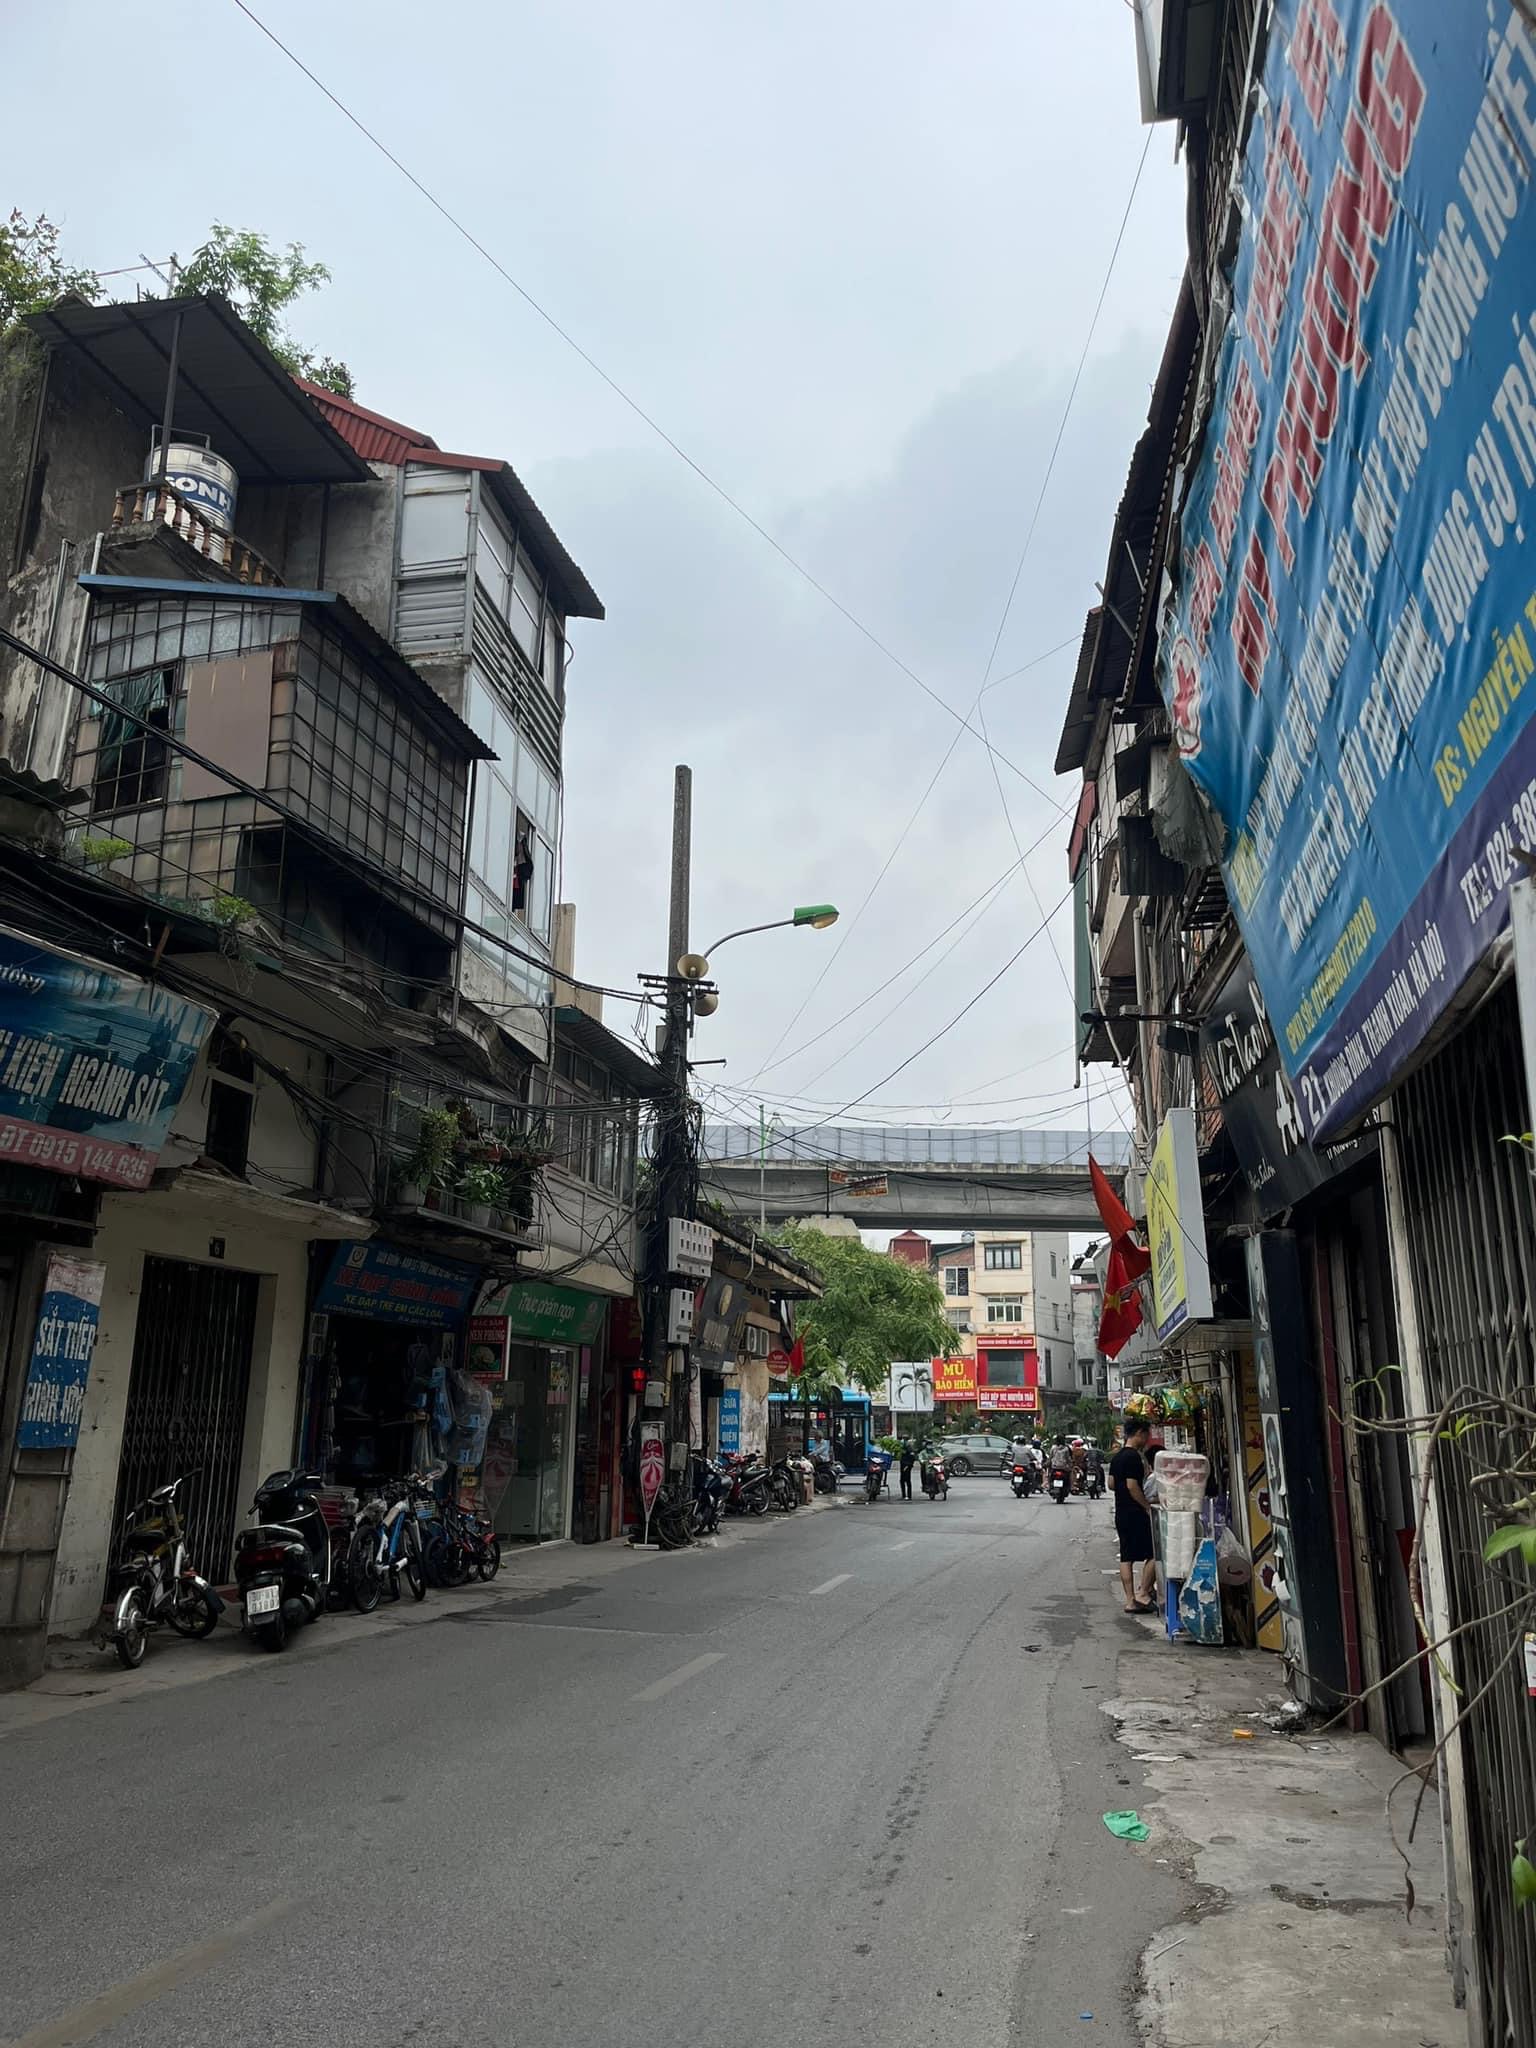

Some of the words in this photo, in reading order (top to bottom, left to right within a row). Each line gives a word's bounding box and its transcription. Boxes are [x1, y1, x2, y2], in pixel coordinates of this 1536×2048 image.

[1260, 0, 1427, 576] PHƯỢNG
[1405, 203, 1488, 417] ĐƯỜNG
[1378, 332, 1427, 491] THỬ
[1352, 440, 1400, 572] MÁY
[1299, 607, 1331, 721] THỬ
[1314, 591, 1349, 676] MA
[1338, 727, 1376, 828] MÁY
[1422, 490, 1489, 646] DỤNG
[1467, 422, 1523, 546] CỤ
[1285, 675, 1316, 767] QUE
[1434, 746, 1467, 806] DS:
[1458, 624, 1534, 767] NGUYỄN
[1460, 863, 1493, 924] TEL:
[1362, 1000, 1393, 1058] THANH
[1385, 970, 1418, 1030] XUÂN,
[1408, 942, 1430, 998] HÀ
[1421, 920, 1445, 981] NỘI
[2, 1032, 64, 1104] KIỆN
[59, 1051, 135, 1118] NGÀNH
[128, 1063, 169, 1125] SẮT
[31, 1134, 79, 1164] 0915
[83, 1146, 115, 1173] 144
[36, 1308, 65, 1357] SẮT
[935, 1377, 952, 1390] BẢO
[953, 1375, 974, 1390] HIỂM
[943, 1360, 964, 1376] MŨ
